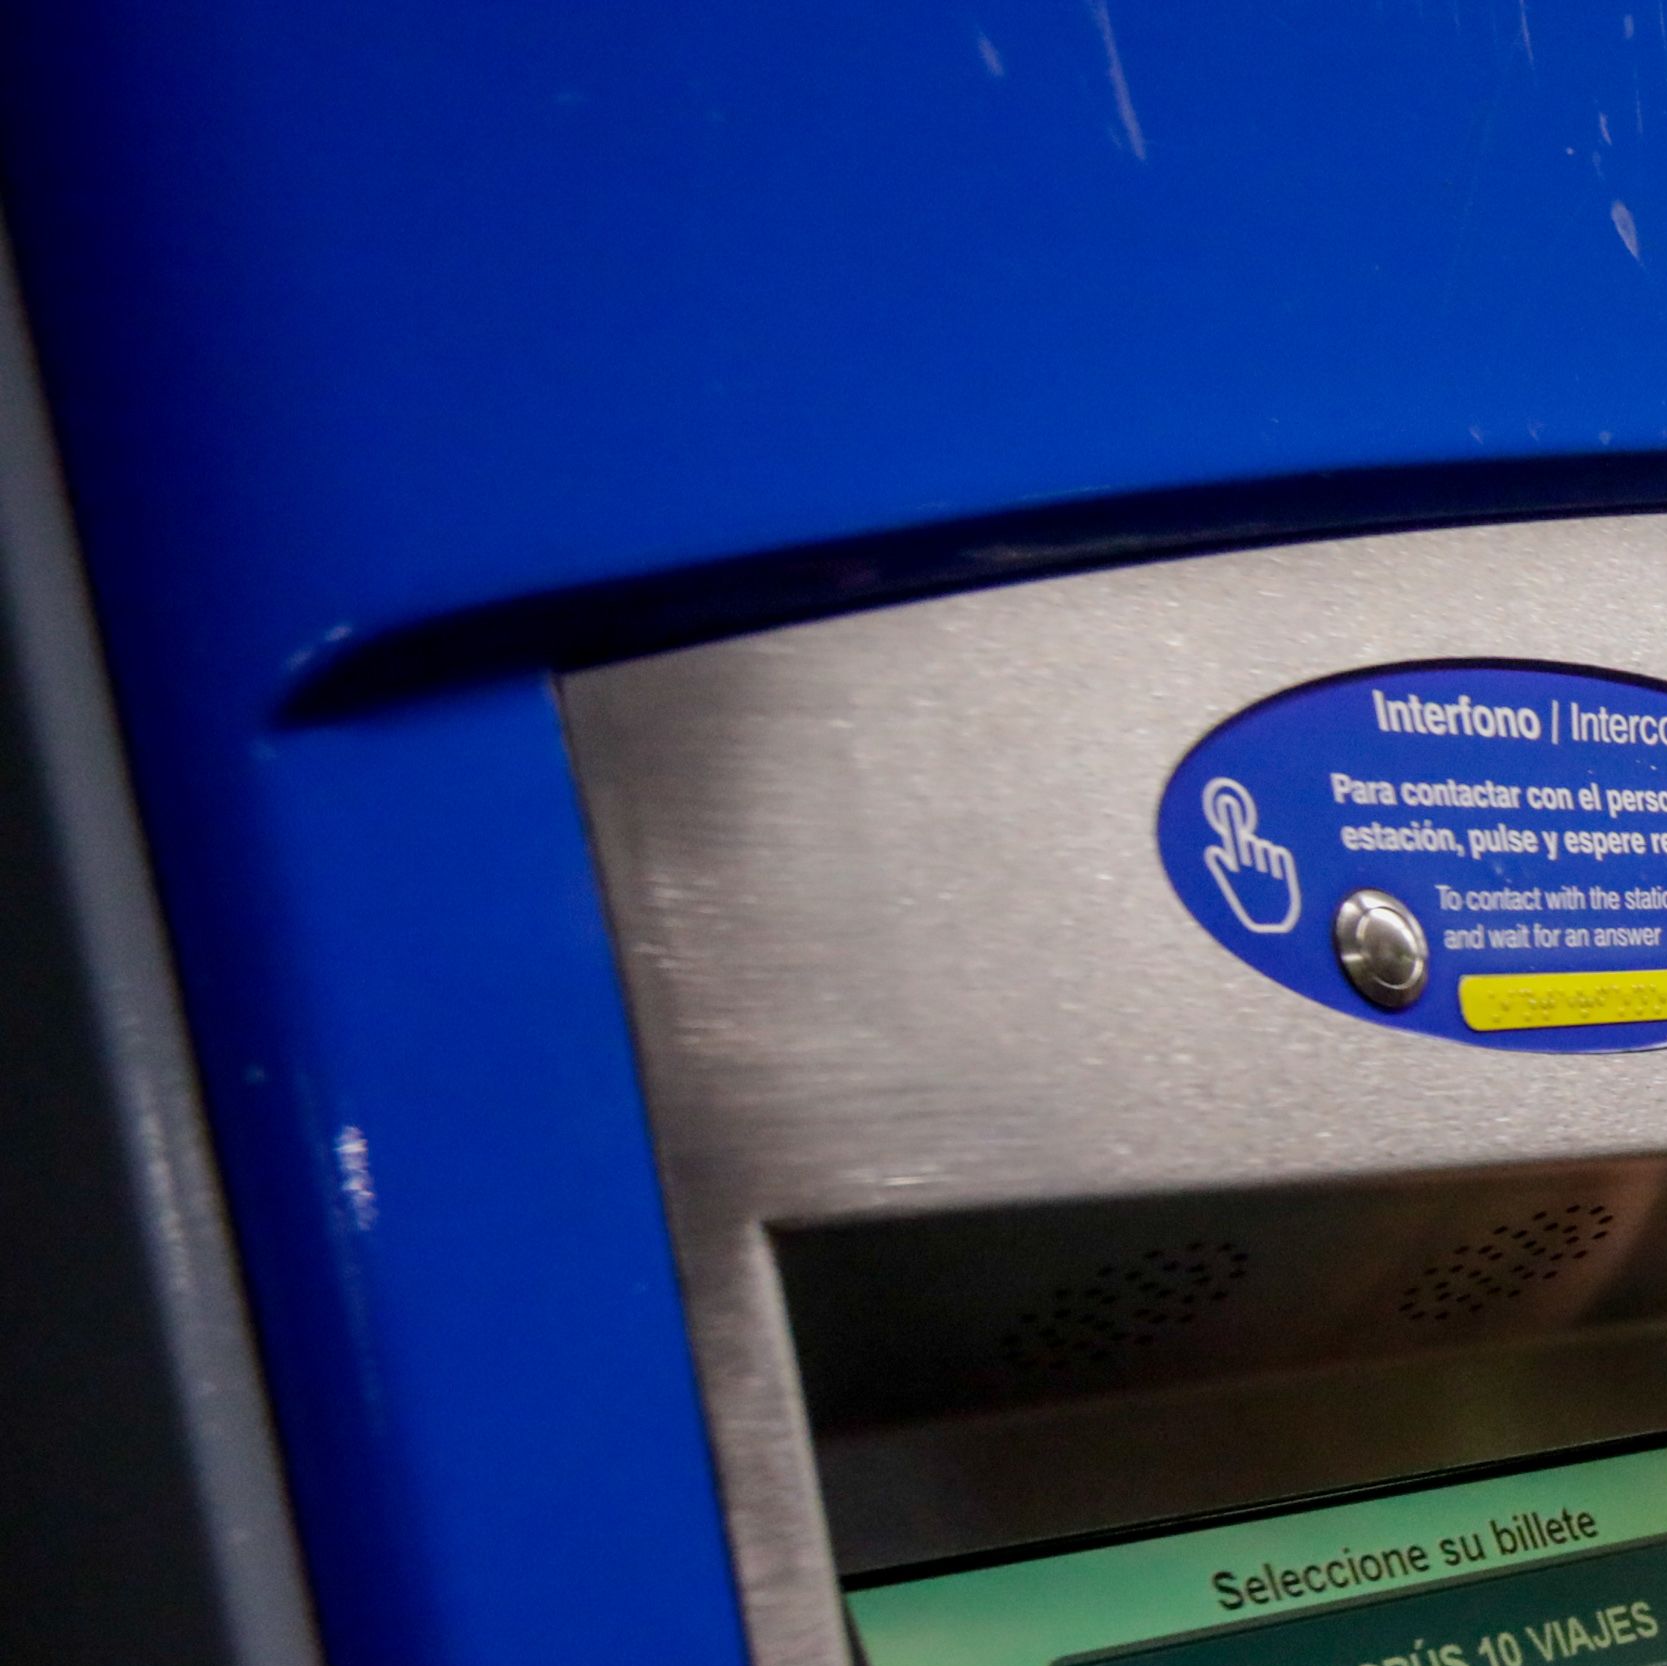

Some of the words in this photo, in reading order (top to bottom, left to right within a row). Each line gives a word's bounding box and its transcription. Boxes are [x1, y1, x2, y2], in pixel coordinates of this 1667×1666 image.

[1372, 689, 1541, 740] Interfono
[1330, 773, 1398, 805] Para
[1401, 779, 1521, 808] contactar
[1526, 786, 1574, 810] con
[1578, 782, 1602, 811] el
[1341, 819, 1465, 858] estación,
[1468, 823, 1539, 861] pulse
[1542, 830, 1560, 861] y
[1564, 831, 1646, 861] espere
[1434, 884, 1463, 911] To
[1466, 887, 1543, 911] contact
[1545, 885, 1586, 911] with
[1589, 886, 1620, 911] the
[1444, 923, 1485, 950] and
[1488, 923, 1531, 949] wait
[1533, 923, 1562, 949] for
[1565, 927, 1590, 948] an
[1593, 927, 1662, 947] answer
[1211, 1541, 1430, 1611] Seleccione
[1439, 1533, 1485, 1567] su
[1489, 1507, 1599, 1556] billete
[1525, 1601, 1660, 1662] VIAJES
